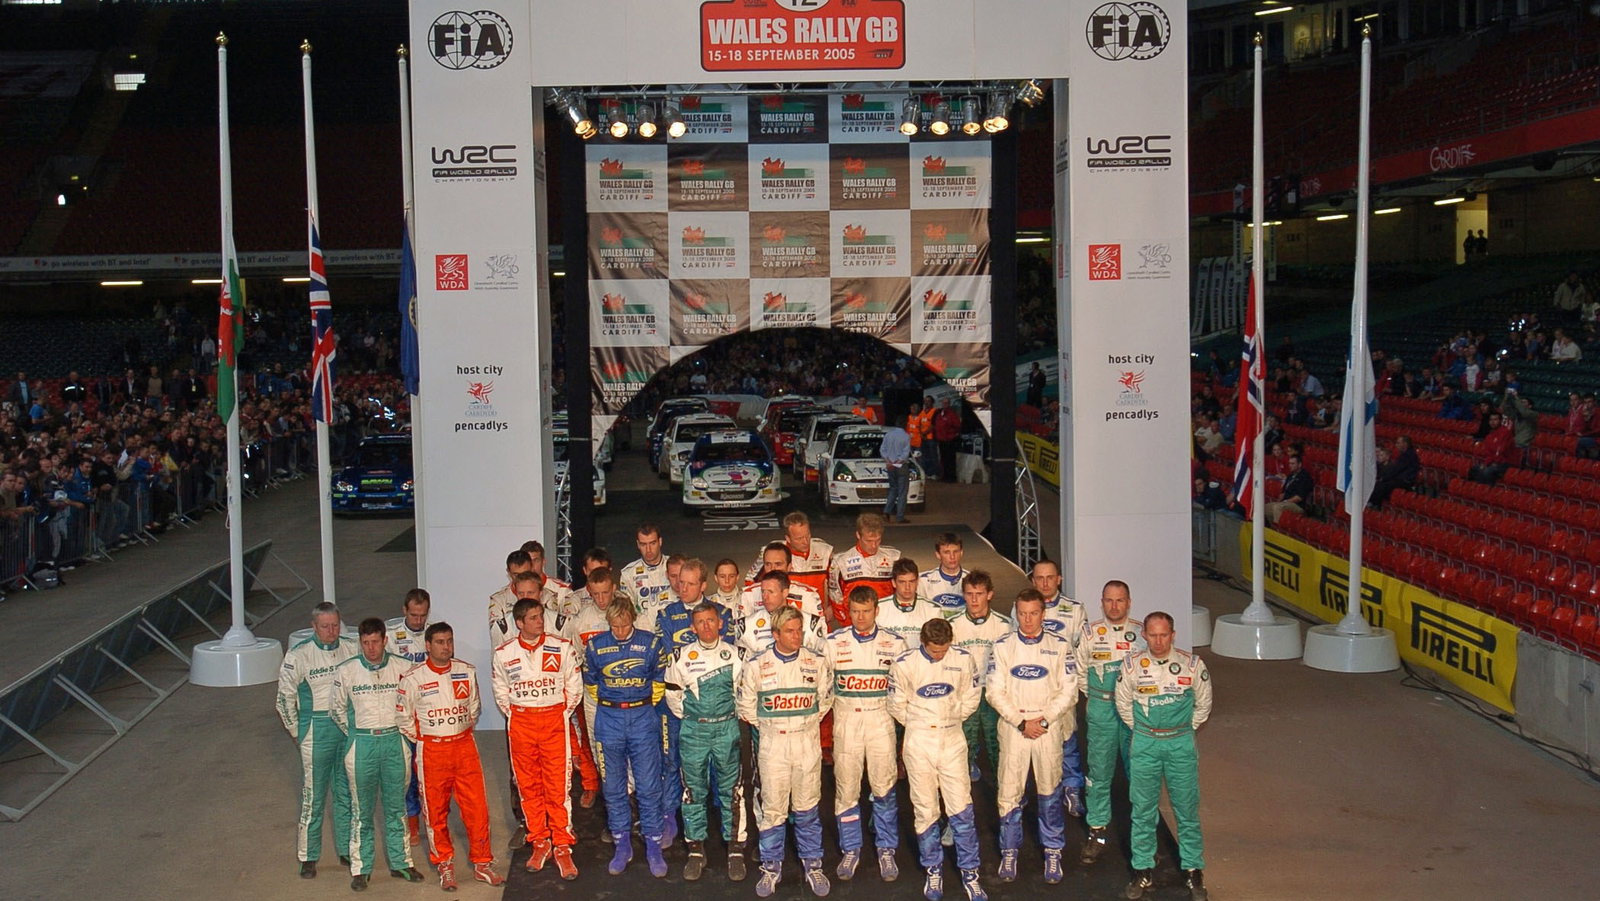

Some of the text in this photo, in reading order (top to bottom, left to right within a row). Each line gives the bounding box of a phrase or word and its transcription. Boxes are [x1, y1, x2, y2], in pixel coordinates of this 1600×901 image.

[707, 16, 898, 44] WALES RALLY GB
[708, 48, 856, 62] 15-18 SEPTEMBER 2005
[681, 112, 732, 122] ALES RALLY GB
[760, 112, 814, 122] WALES RALLY GB
[841, 112, 895, 121] WALES RALLY GB
[1086, 135, 1172, 154] WRC
[431, 145, 517, 164] WRC
[600, 180, 653, 189] WALES RALLY GB
[680, 180, 735, 188] WALES RALLY GB
[761, 179, 815, 188] WALES RALLY GB
[842, 178, 896, 187] WALES RALLY GB
[922, 177, 976, 186] WALES RALLY GB
[600, 248, 623, 256] WALES
[624, 248, 644, 256] RALLY
[682, 248, 705, 256] WALES
[706, 247, 725, 256] RALLY
[762, 247, 785, 255] WALES
[786, 246, 806, 255] RALLY
[842, 246, 865, 255] WALES
[866, 246, 886, 255] RALLY
[923, 244, 946, 253] WALES
[947, 244, 967, 253] RALLY
[440, 281, 465, 289] WDA
[1108, 354, 1155, 365] host city
[457, 364, 503, 376] host city
[1106, 409, 1158, 421] pencadlys
[455, 420, 508, 432] pencadlys
[1250, 540, 1300, 593] PRELLI
[1320, 564, 1384, 628] PIRLI
[1410, 601, 1497, 686] PIRELLI
[310, 667, 328, 676] Eddie
[1018, 666, 1040, 677] Ford
[604, 678, 646, 688] SUBARU
[516, 687, 556, 698] SPORT
[924, 686, 947, 696] Ford
[429, 715, 468, 727] SPORT
